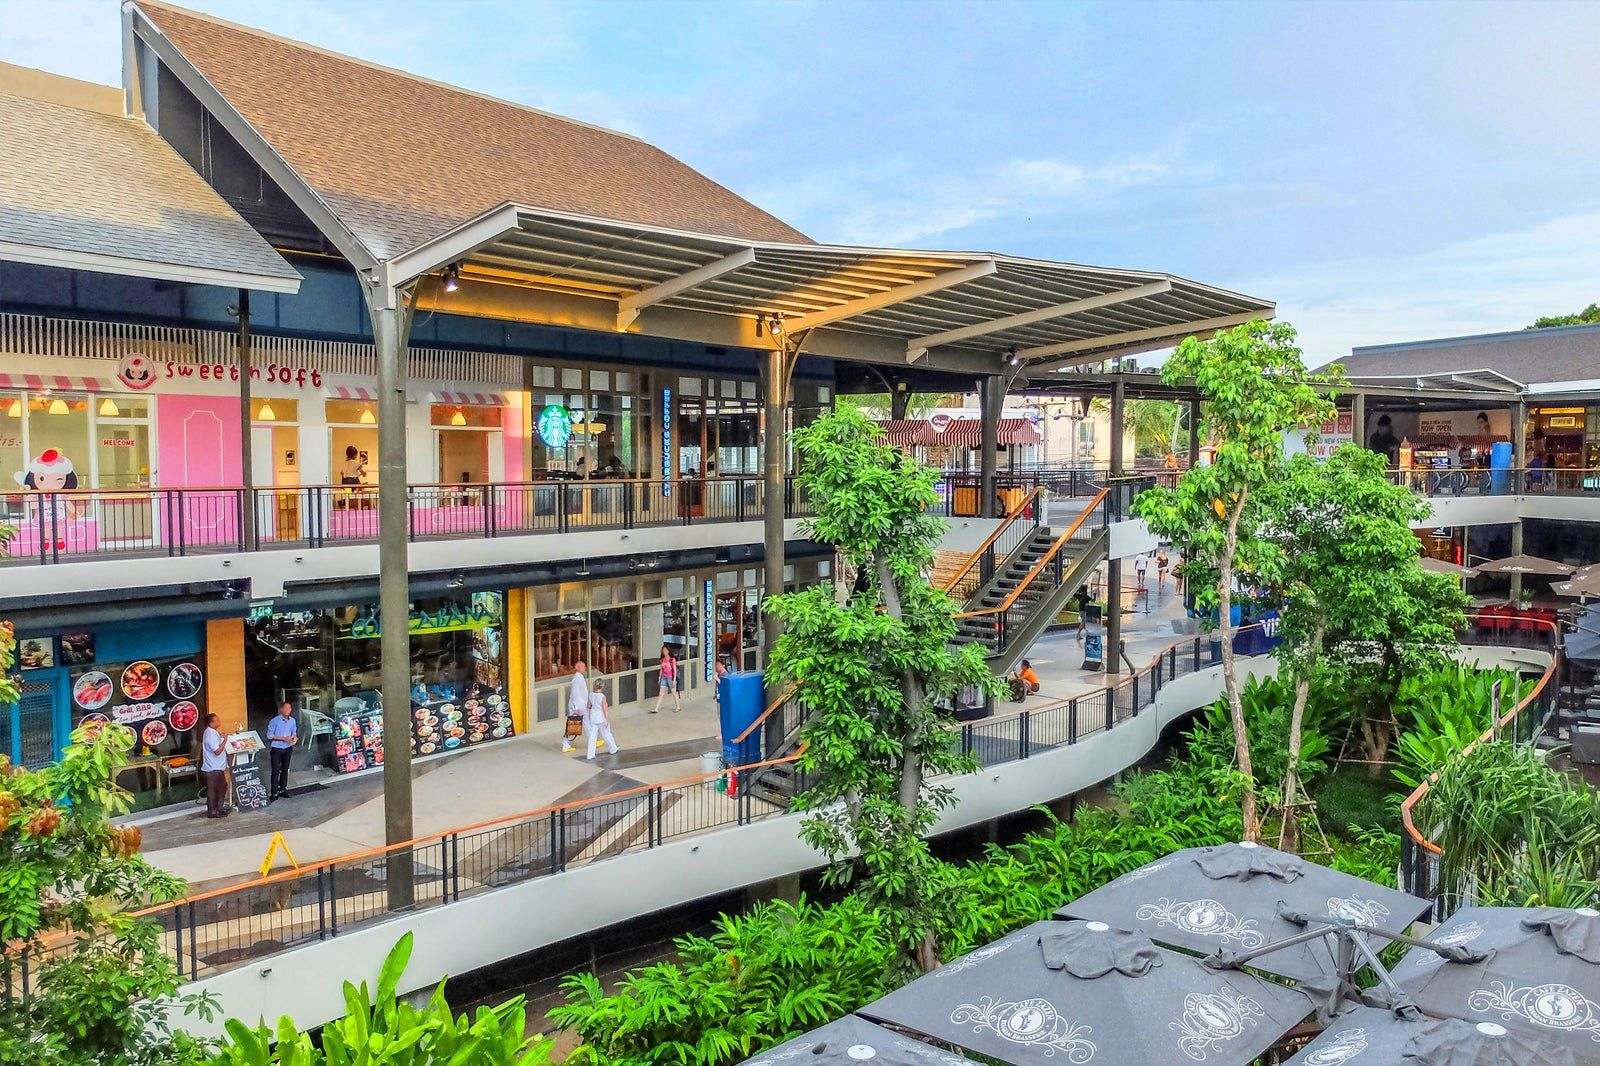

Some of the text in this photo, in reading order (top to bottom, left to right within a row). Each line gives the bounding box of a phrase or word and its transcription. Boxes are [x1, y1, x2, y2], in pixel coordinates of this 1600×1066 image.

[165, 361, 240, 381] Sweet
[705, 580, 713, 682] STARBUCKS COFFEE
